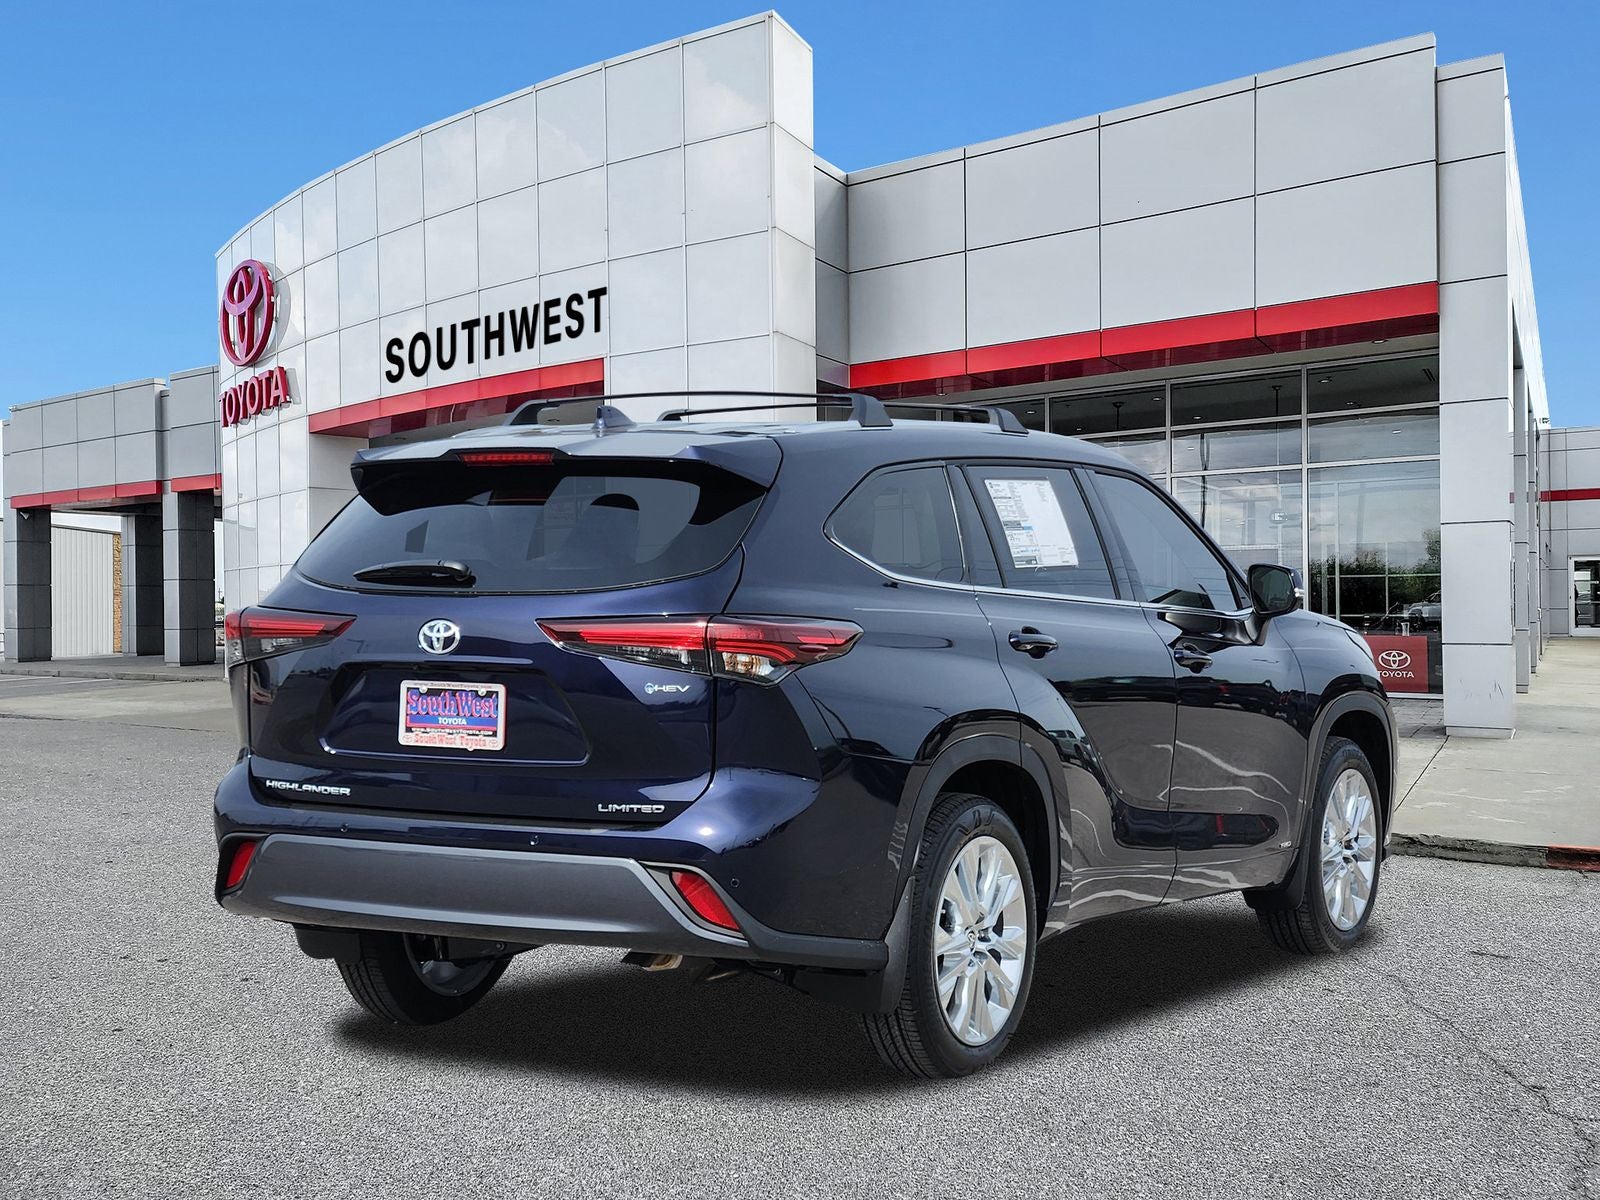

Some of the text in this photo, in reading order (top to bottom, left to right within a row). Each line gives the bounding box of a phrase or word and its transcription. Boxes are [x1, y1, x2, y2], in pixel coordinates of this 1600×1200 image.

[385, 286, 608, 384] SOUTHWEST
[218, 366, 291, 428] TOYOTA
[1377, 670, 1414, 678] TOYOTA
[654, 685, 691, 693] HEV
[407, 689, 497, 718] SouthWest
[438, 717, 467, 725] TOYOTA
[265, 779, 351, 796] HIGHLANDER
[597, 803, 665, 814] LIMITED
